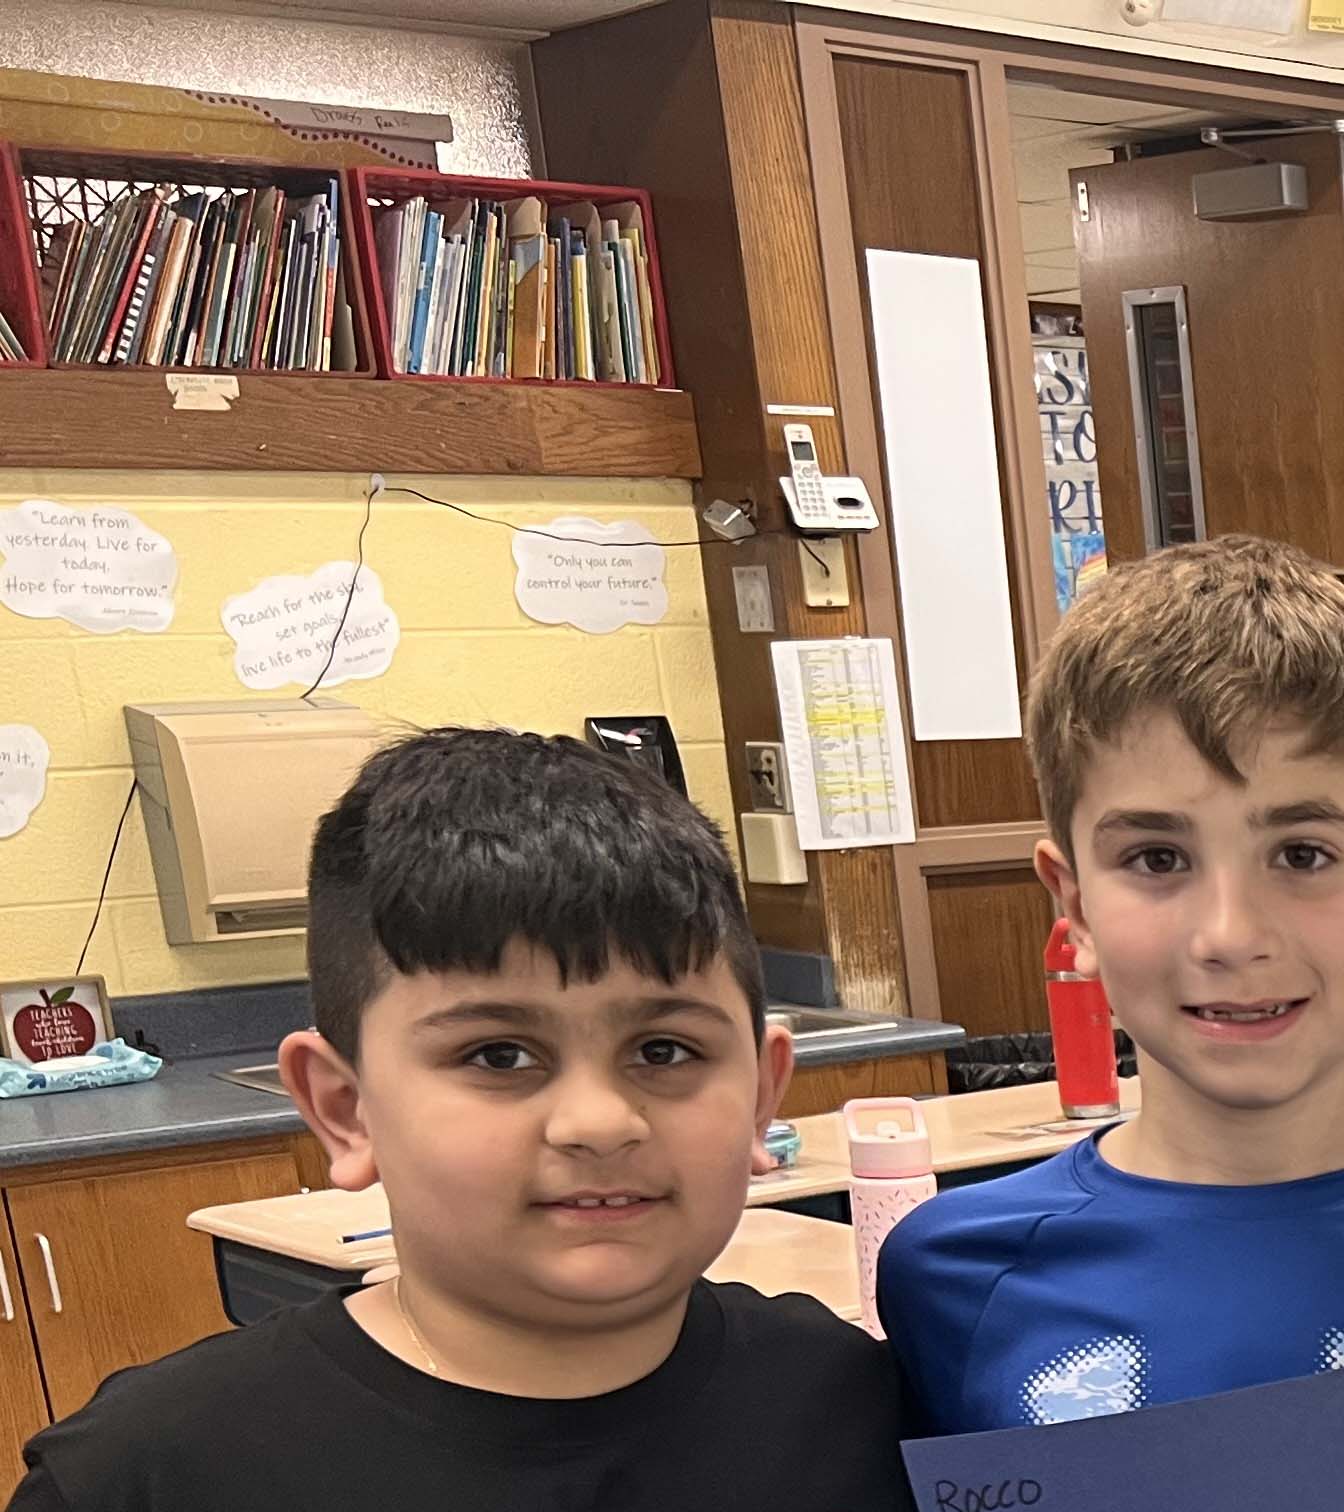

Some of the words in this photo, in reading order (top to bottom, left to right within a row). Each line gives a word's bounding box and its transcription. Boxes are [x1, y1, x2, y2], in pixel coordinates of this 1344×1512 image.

[92, 513, 129, 529] from
[97, 536, 129, 551] Live
[136, 537, 158, 552] for
[585, 556, 608, 570] you
[611, 556, 633, 568] can
[6, 576, 47, 596] Hope
[53, 578, 75, 594] for
[527, 575, 571, 591] control
[574, 578, 602, 592] your
[283, 598, 302, 615] for
[309, 588, 334, 606] the
[275, 624, 298, 642] set
[241, 659, 268, 678] live
[270, 650, 294, 669] life
[296, 646, 312, 660] to
[30, 1007, 73, 1022] TEACHERS
[33, 1025, 78, 1040] TEACHING
